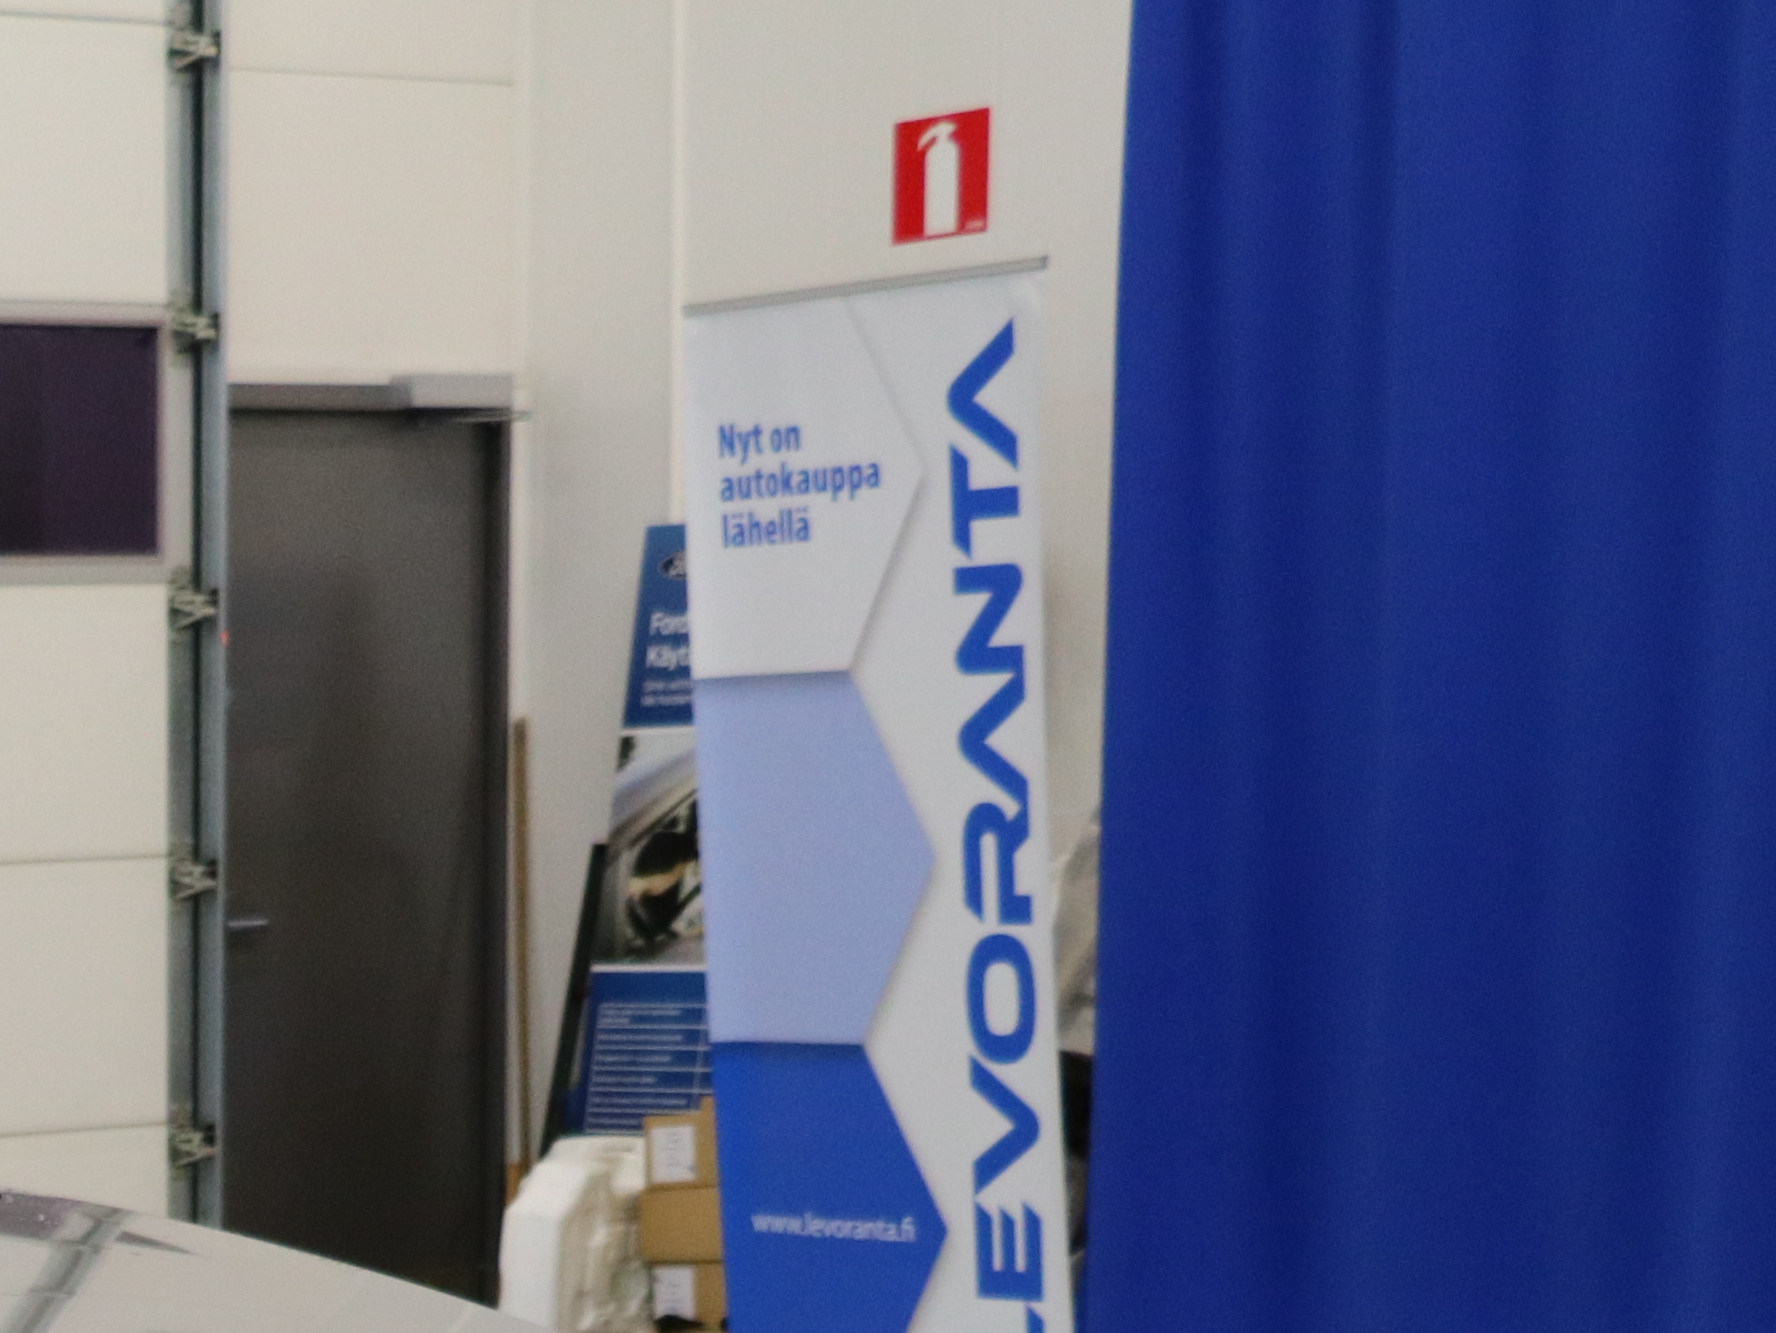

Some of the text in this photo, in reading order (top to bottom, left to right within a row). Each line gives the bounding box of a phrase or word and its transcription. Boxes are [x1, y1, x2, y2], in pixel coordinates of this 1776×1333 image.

[719, 424, 801, 466] Nyt on
[721, 461, 880, 502] autokauppa
[723, 506, 811, 548] lähellä
[751, 1212, 915, 1242] www.levoranta.fi
